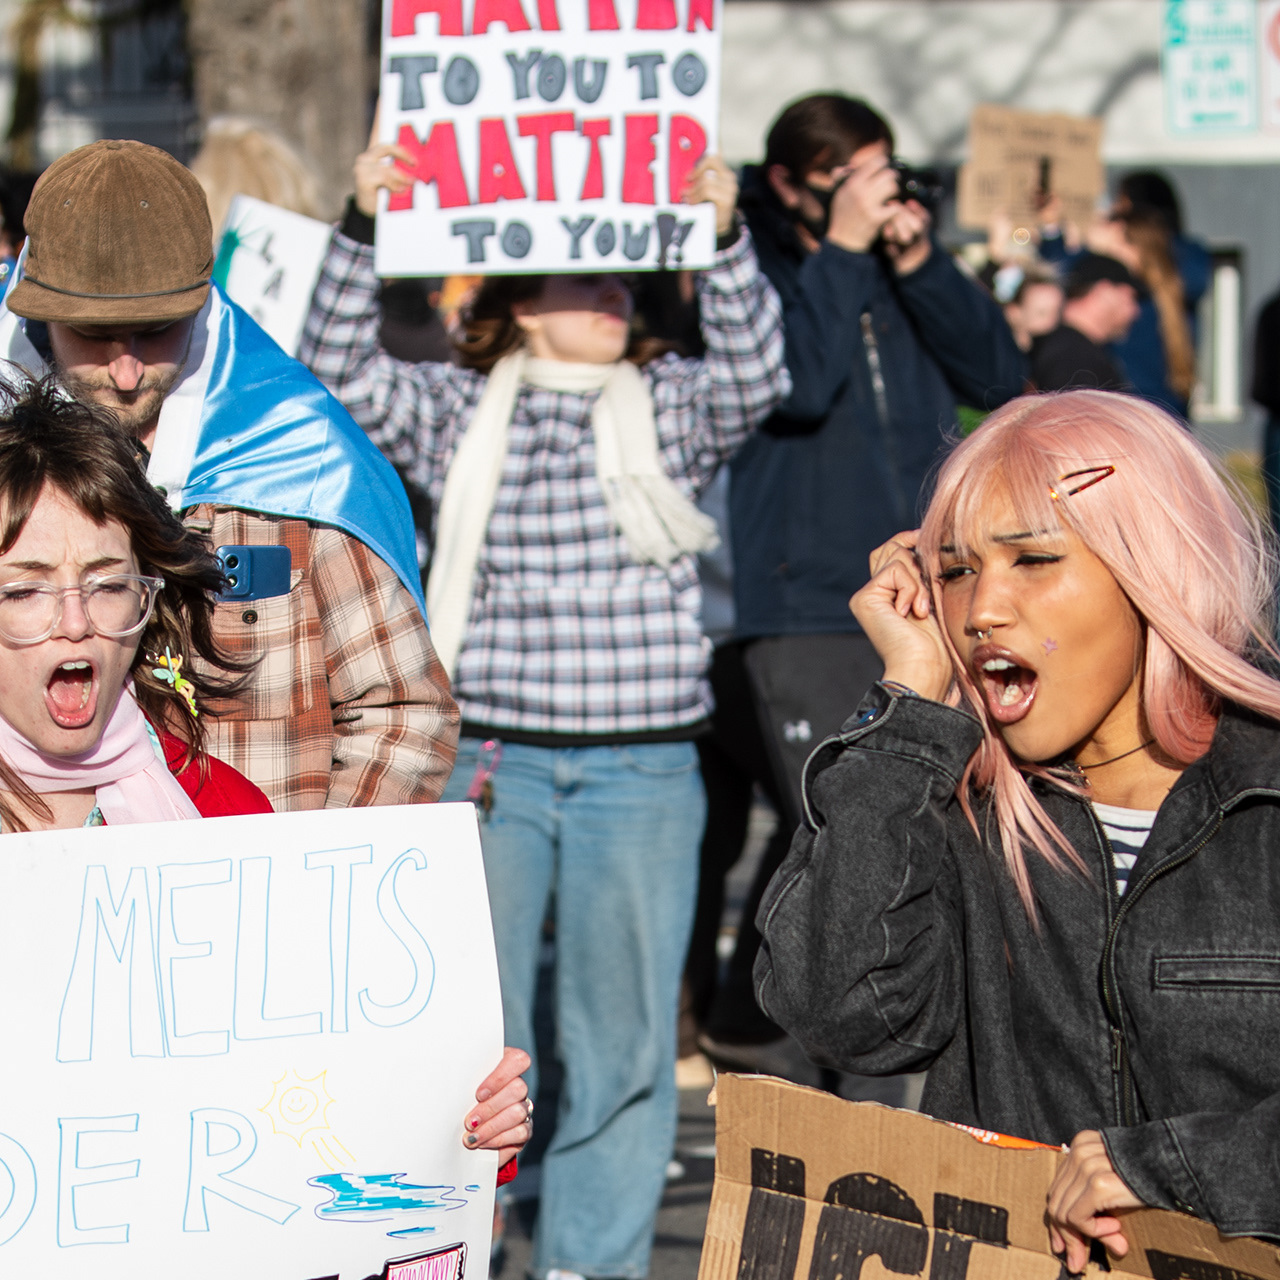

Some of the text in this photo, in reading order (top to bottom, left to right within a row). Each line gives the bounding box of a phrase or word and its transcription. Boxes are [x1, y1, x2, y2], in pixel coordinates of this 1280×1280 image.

[389, 48, 707, 111] TO YOU TO
[387, 111, 707, 212] MATTER
[451, 219, 533, 264] TO
[56, 844, 436, 1063] MELTS
